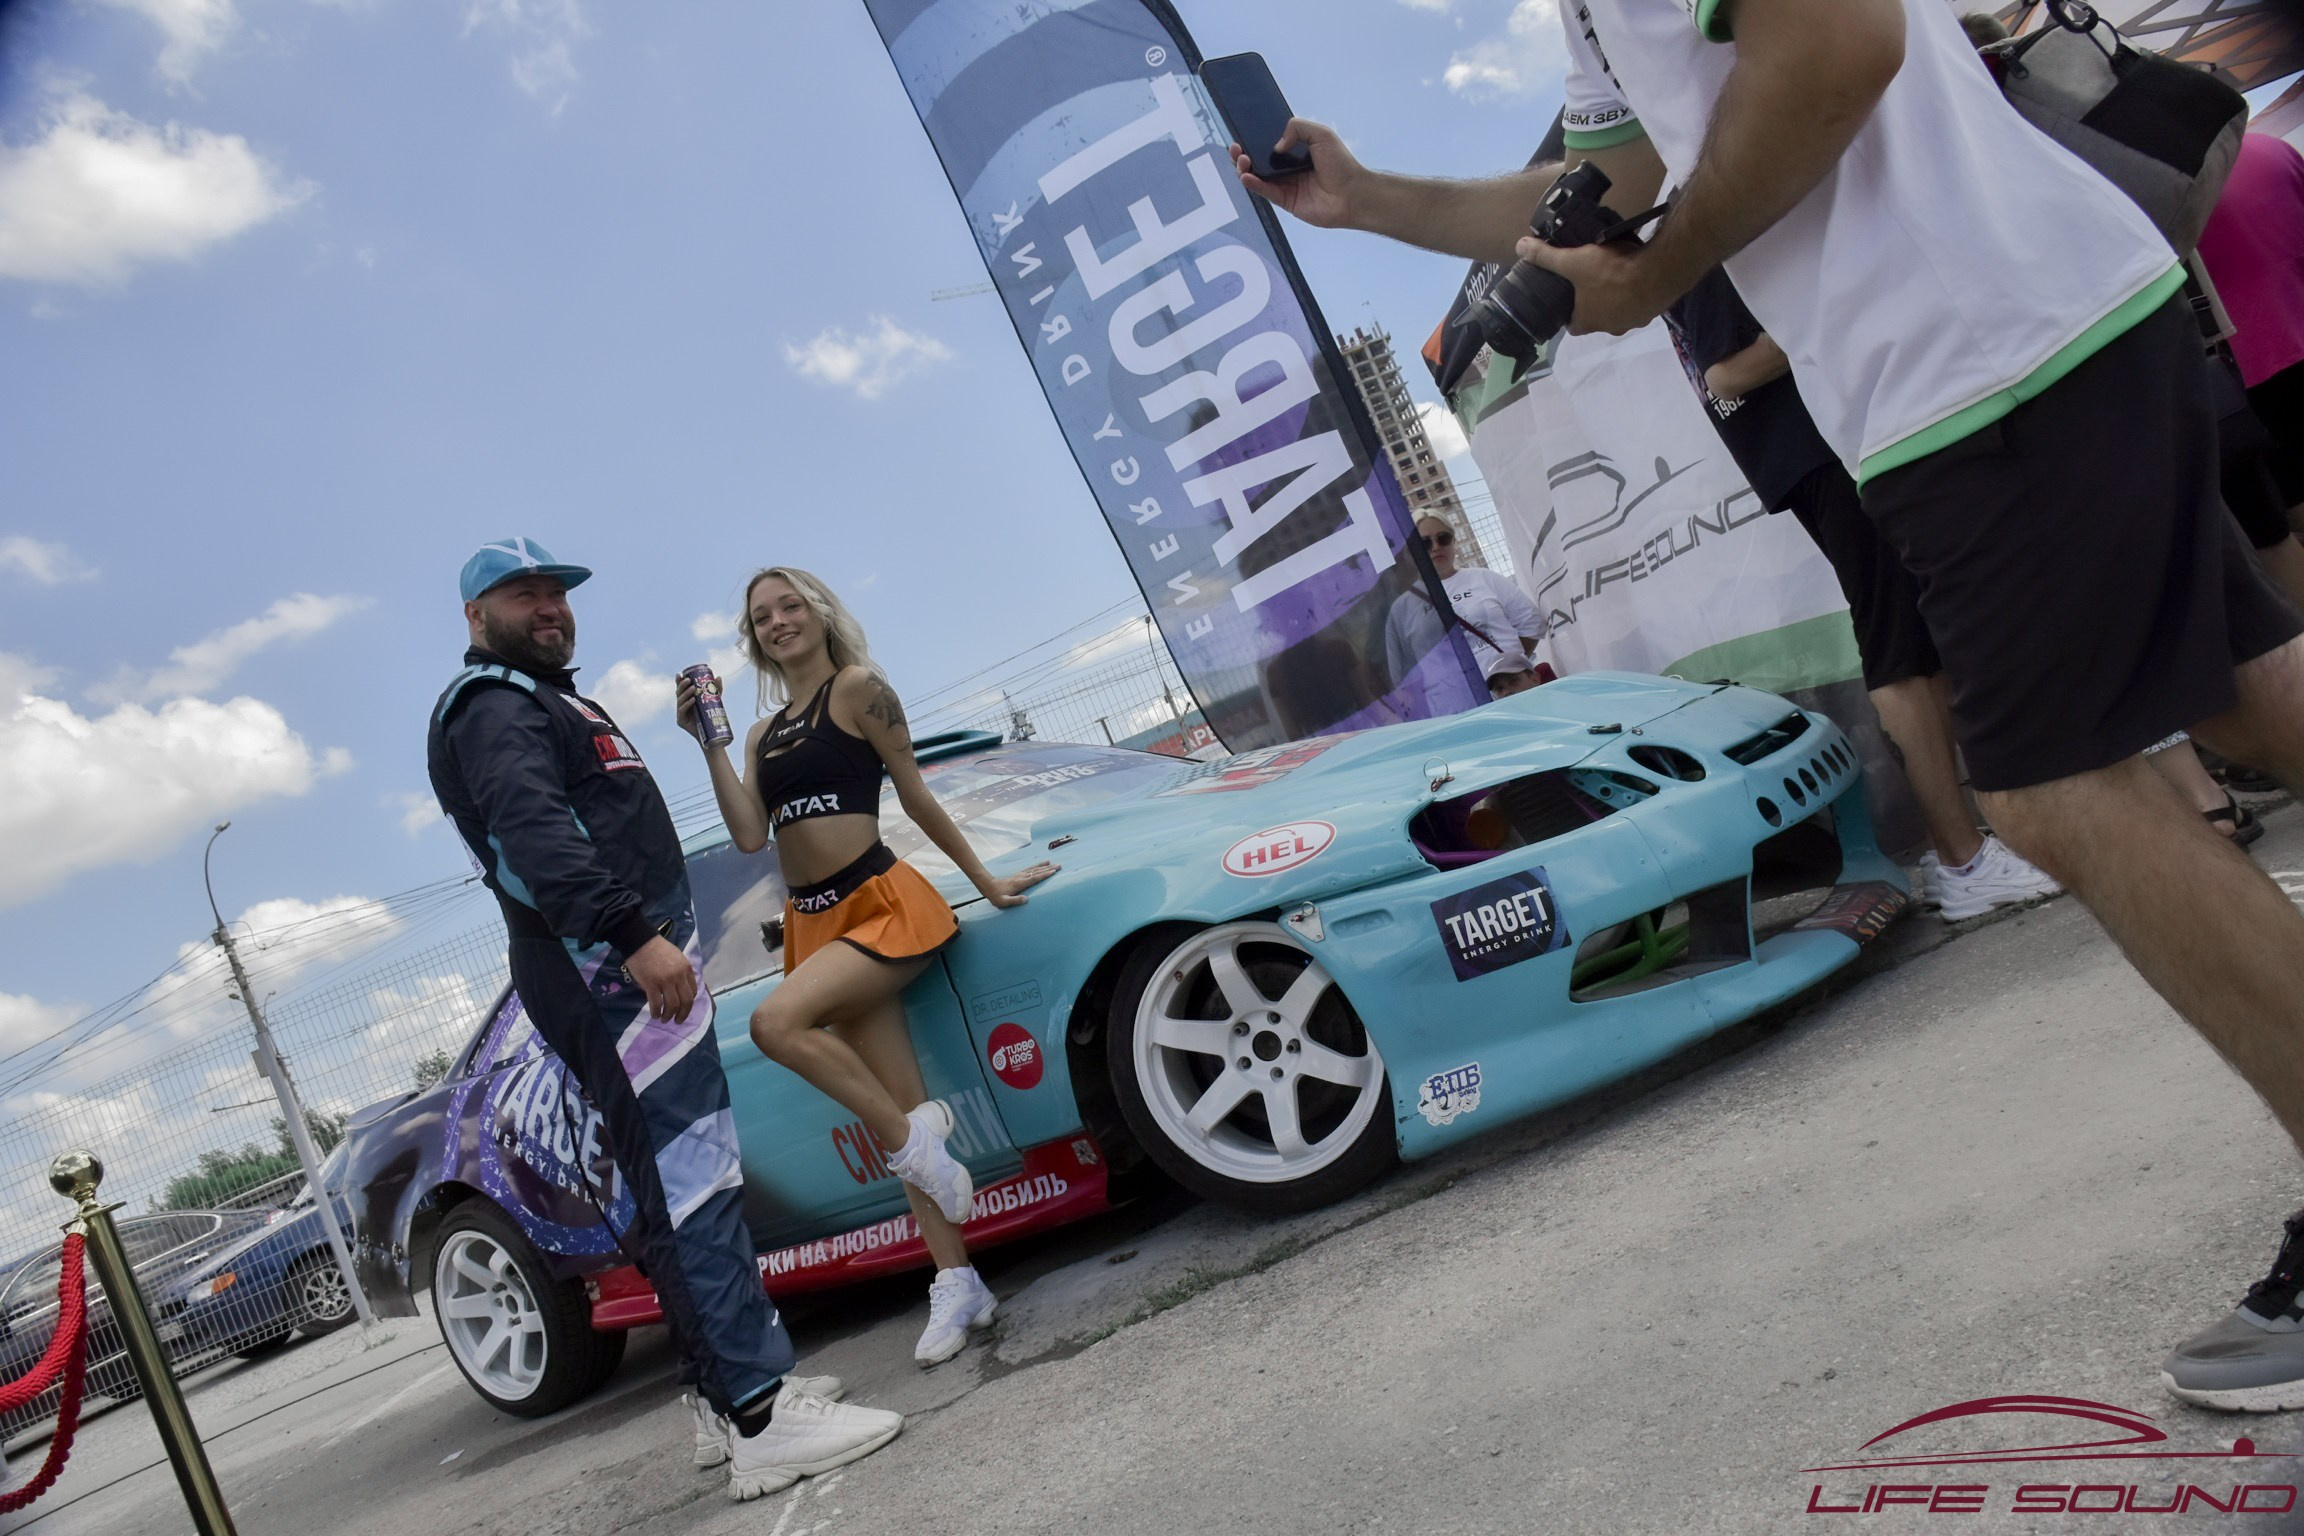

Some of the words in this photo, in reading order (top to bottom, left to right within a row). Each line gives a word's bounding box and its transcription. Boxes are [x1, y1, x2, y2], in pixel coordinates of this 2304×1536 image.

[777, 720, 805, 737] TEAM
[1243, 837, 1314, 869] HEL
[1445, 886, 1548, 949] TARGET
[1463, 940, 1507, 960] ENERGY
[1514, 925, 1552, 942] DRINK
[991, 988, 1039, 1011] DETAILING
[1005, 1039, 1035, 1055] TURBO
[1009, 1050, 1033, 1066] KROS
[484, 1117, 547, 1174] ENERGY
[800, 1241, 828, 1268] НА
[832, 1215, 908, 1260] ЛЮБОЙ
